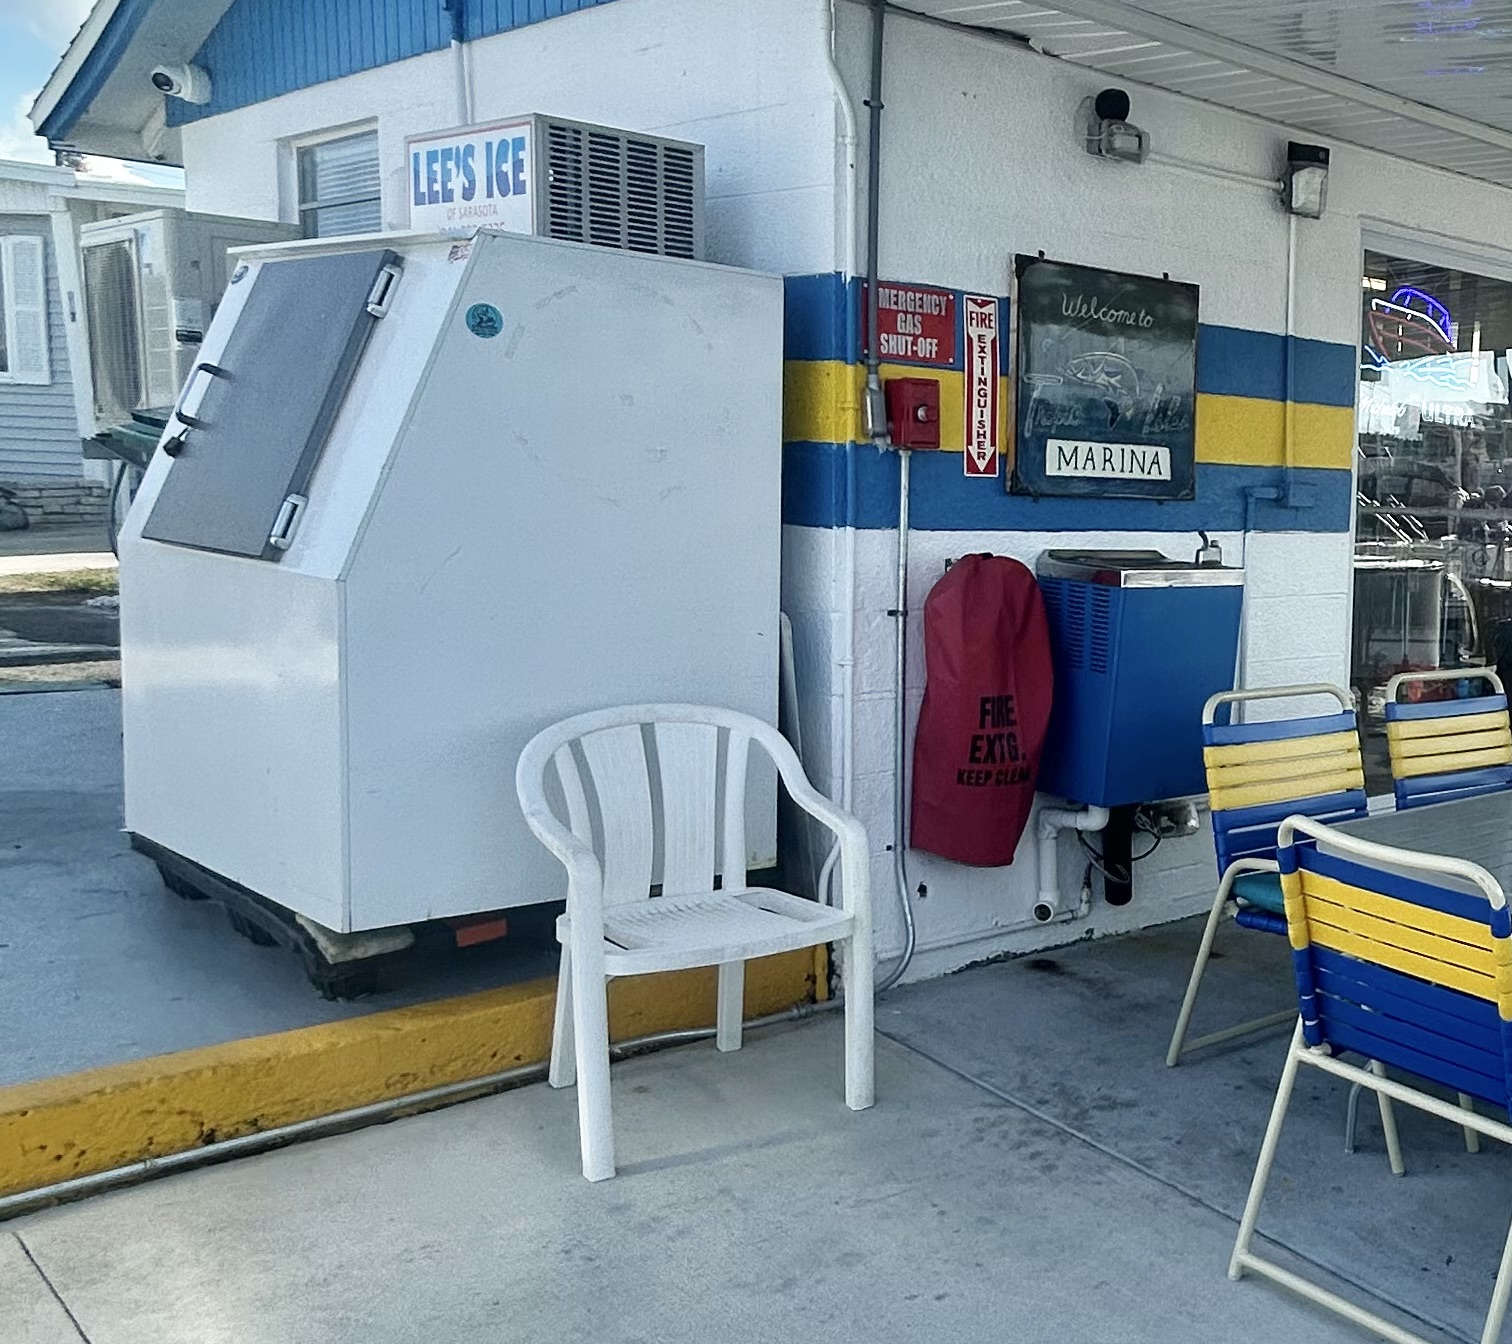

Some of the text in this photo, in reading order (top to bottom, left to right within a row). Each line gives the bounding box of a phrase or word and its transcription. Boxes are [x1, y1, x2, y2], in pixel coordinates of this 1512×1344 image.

[413, 136, 526, 206] LEE'S ICE
[877, 287, 948, 317] MERGENCY
[1062, 293, 1135, 326] Welcome
[896, 312, 922, 335] GAS
[969, 310, 994, 329] FIRE
[880, 333, 938, 358] SHUT-OFF
[977, 334, 988, 461] EXTINGUISHER
[1057, 445, 1163, 476] MARINA
[979, 695, 1017, 729] FIRE
[956, 768, 993, 786] KEEP
